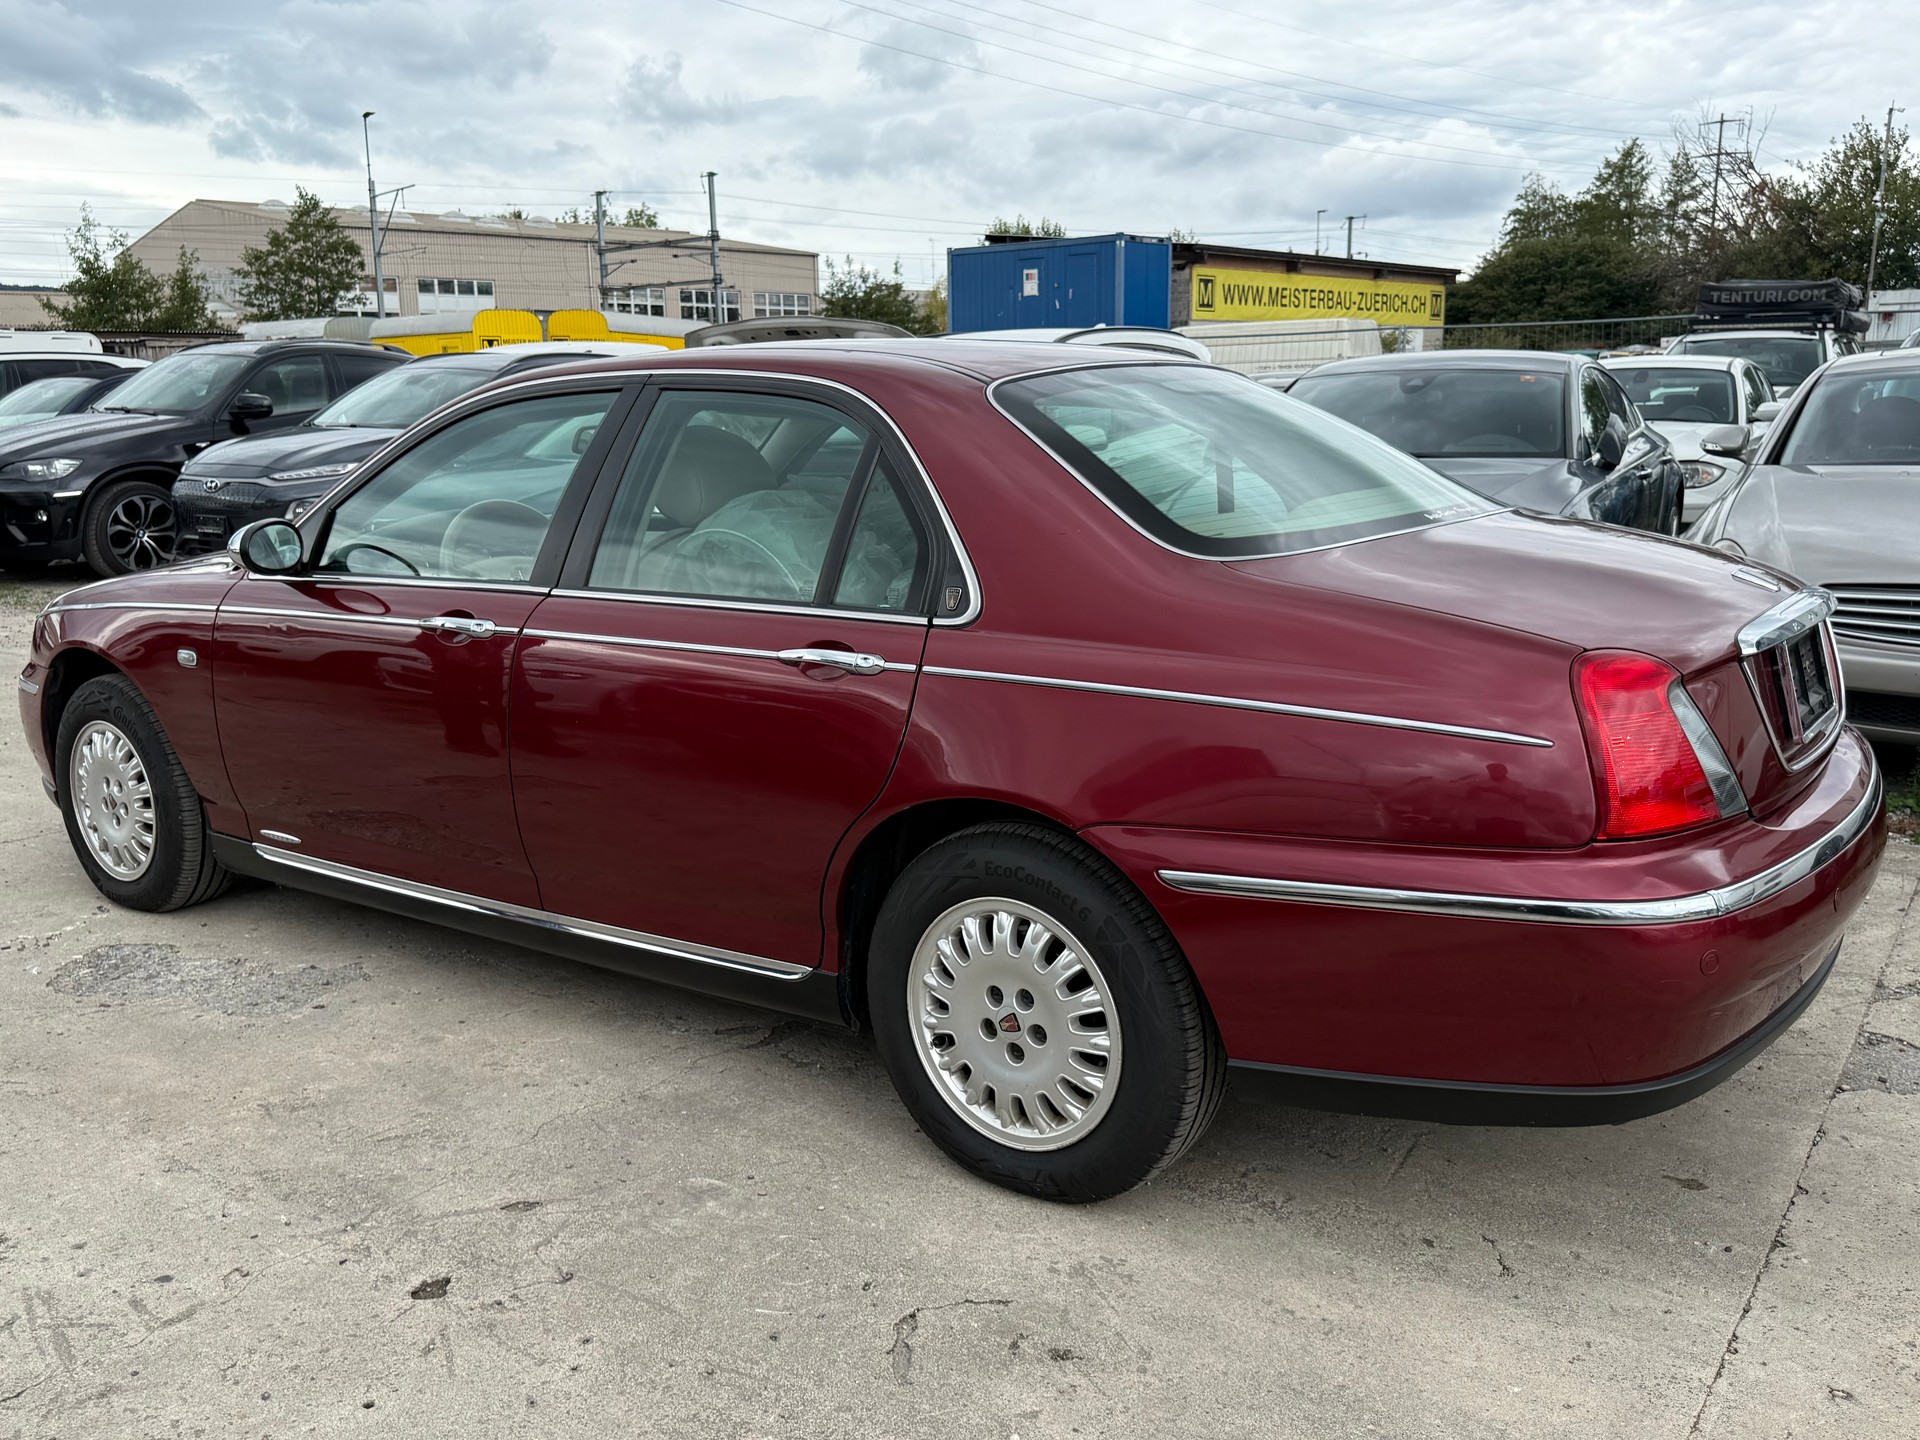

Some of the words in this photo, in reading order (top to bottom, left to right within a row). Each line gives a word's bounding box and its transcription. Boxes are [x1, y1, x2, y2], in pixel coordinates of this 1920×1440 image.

[1222, 283, 1427, 314] WWW.MEISTERBAU-ZUERICH.CH
[1710, 289, 1826, 303] TENTURI.COM
[984, 860, 1079, 911] EcoContact
[1079, 906, 1092, 921] 6
